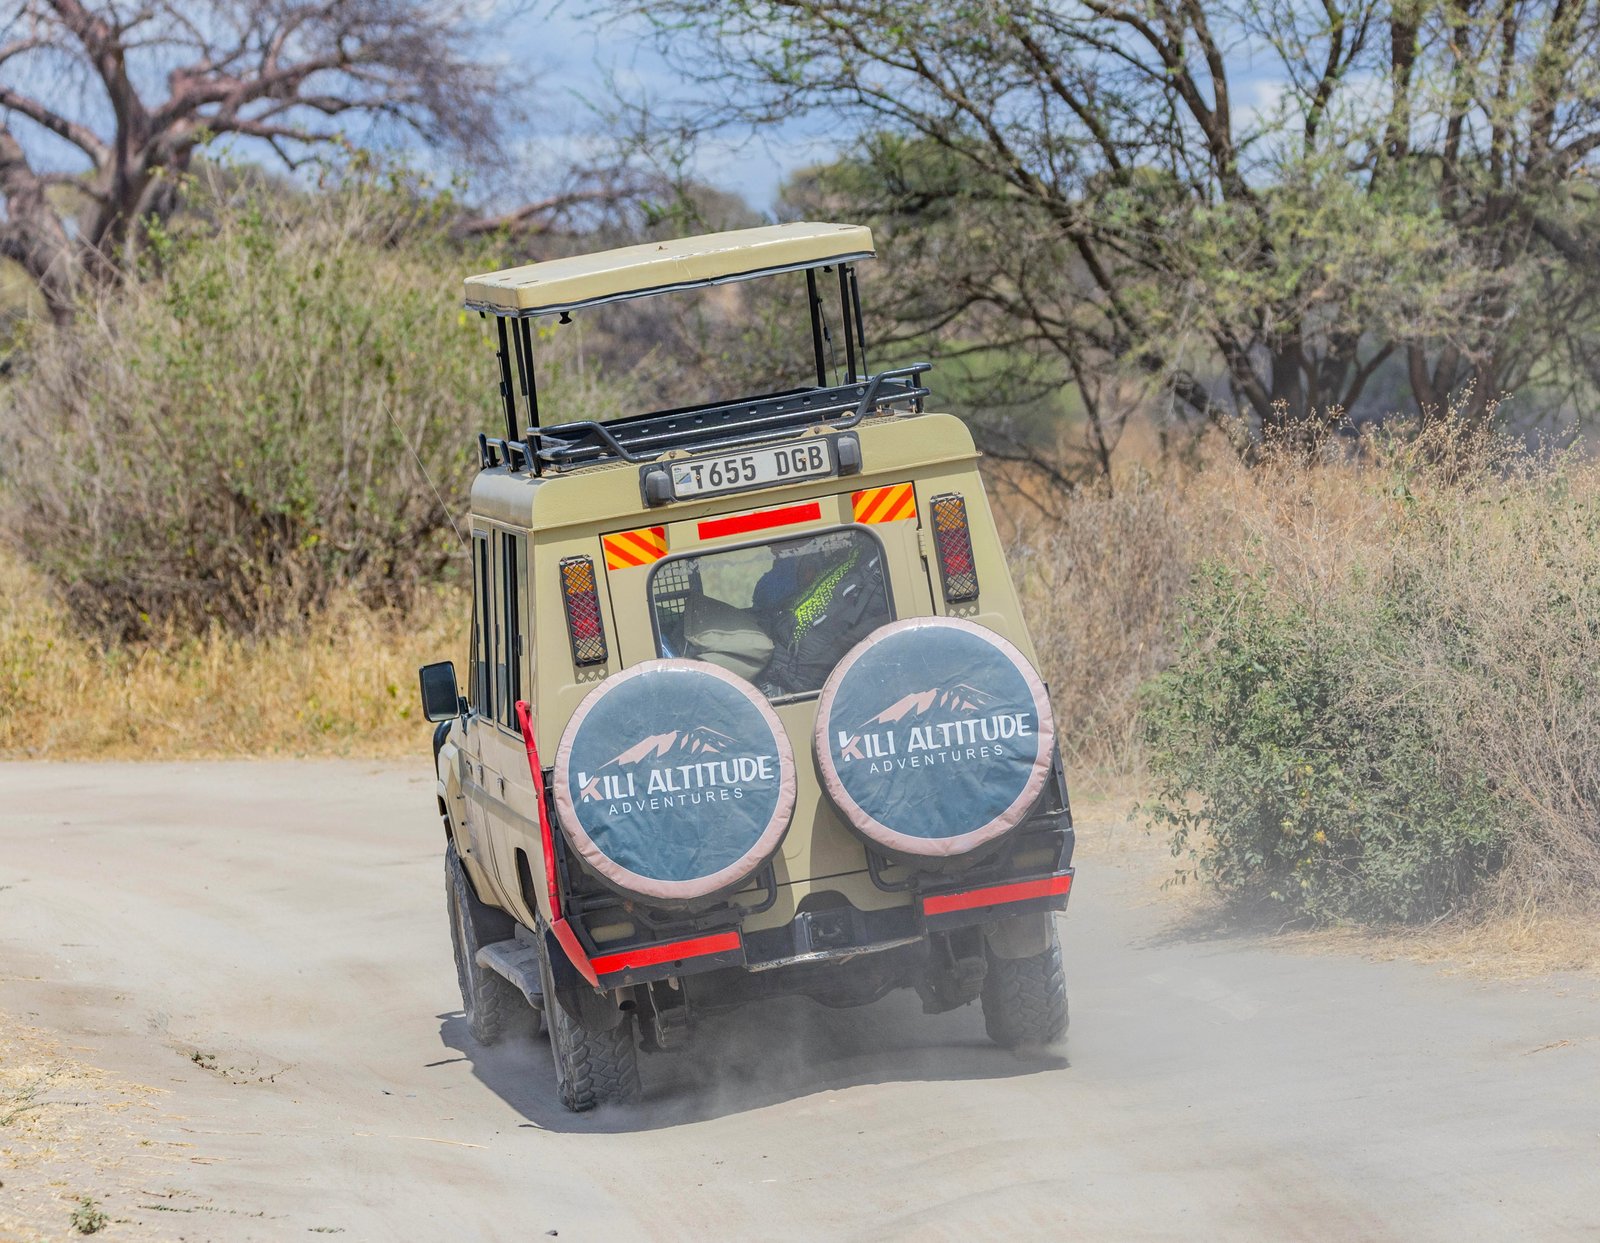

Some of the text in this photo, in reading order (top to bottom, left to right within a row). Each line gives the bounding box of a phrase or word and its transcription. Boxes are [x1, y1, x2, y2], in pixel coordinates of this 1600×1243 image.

[690, 445, 824, 489] T655 DGB
[838, 713, 1033, 762] KILI ALTITUDE
[869, 745, 1003, 774] ADVENTURES
[577, 755, 775, 803] KILI ALTITUDE
[608, 787, 743, 816] ADVENTURES
